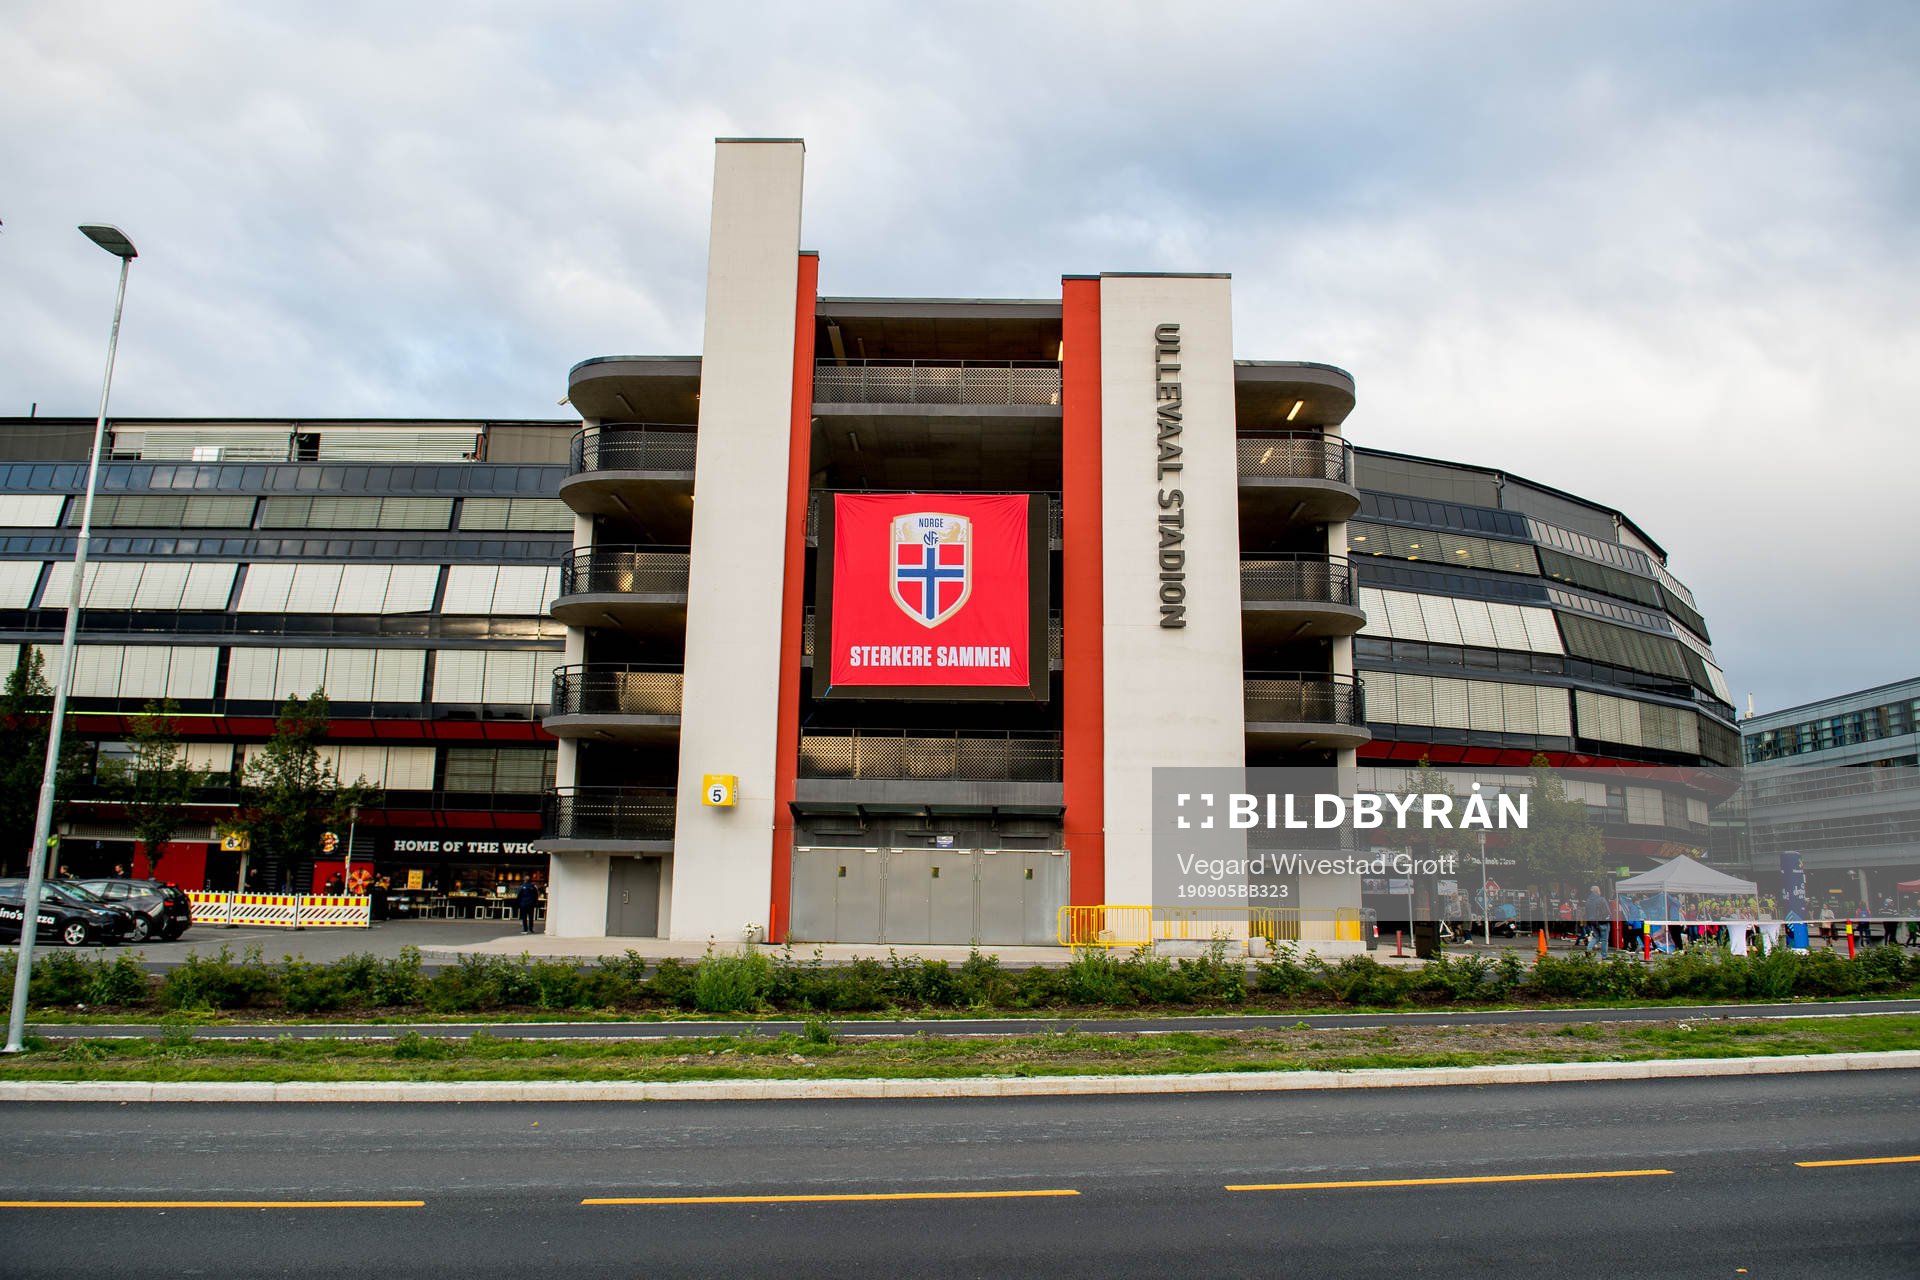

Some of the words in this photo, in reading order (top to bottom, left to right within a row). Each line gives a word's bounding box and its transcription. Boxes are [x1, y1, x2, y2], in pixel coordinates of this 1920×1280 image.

[1155, 323, 1183, 481] ULLEVAAL
[918, 518, 944, 528] NORGE
[1158, 488, 1187, 628] STADION
[850, 645, 932, 667] STERKERE
[936, 646, 1011, 667] SAMMEN
[712, 789, 721, 802] 5
[394, 840, 439, 852] HOME
[442, 841, 463, 852] OF
[467, 842, 499, 853] THE
[502, 842, 551, 854] WHO
